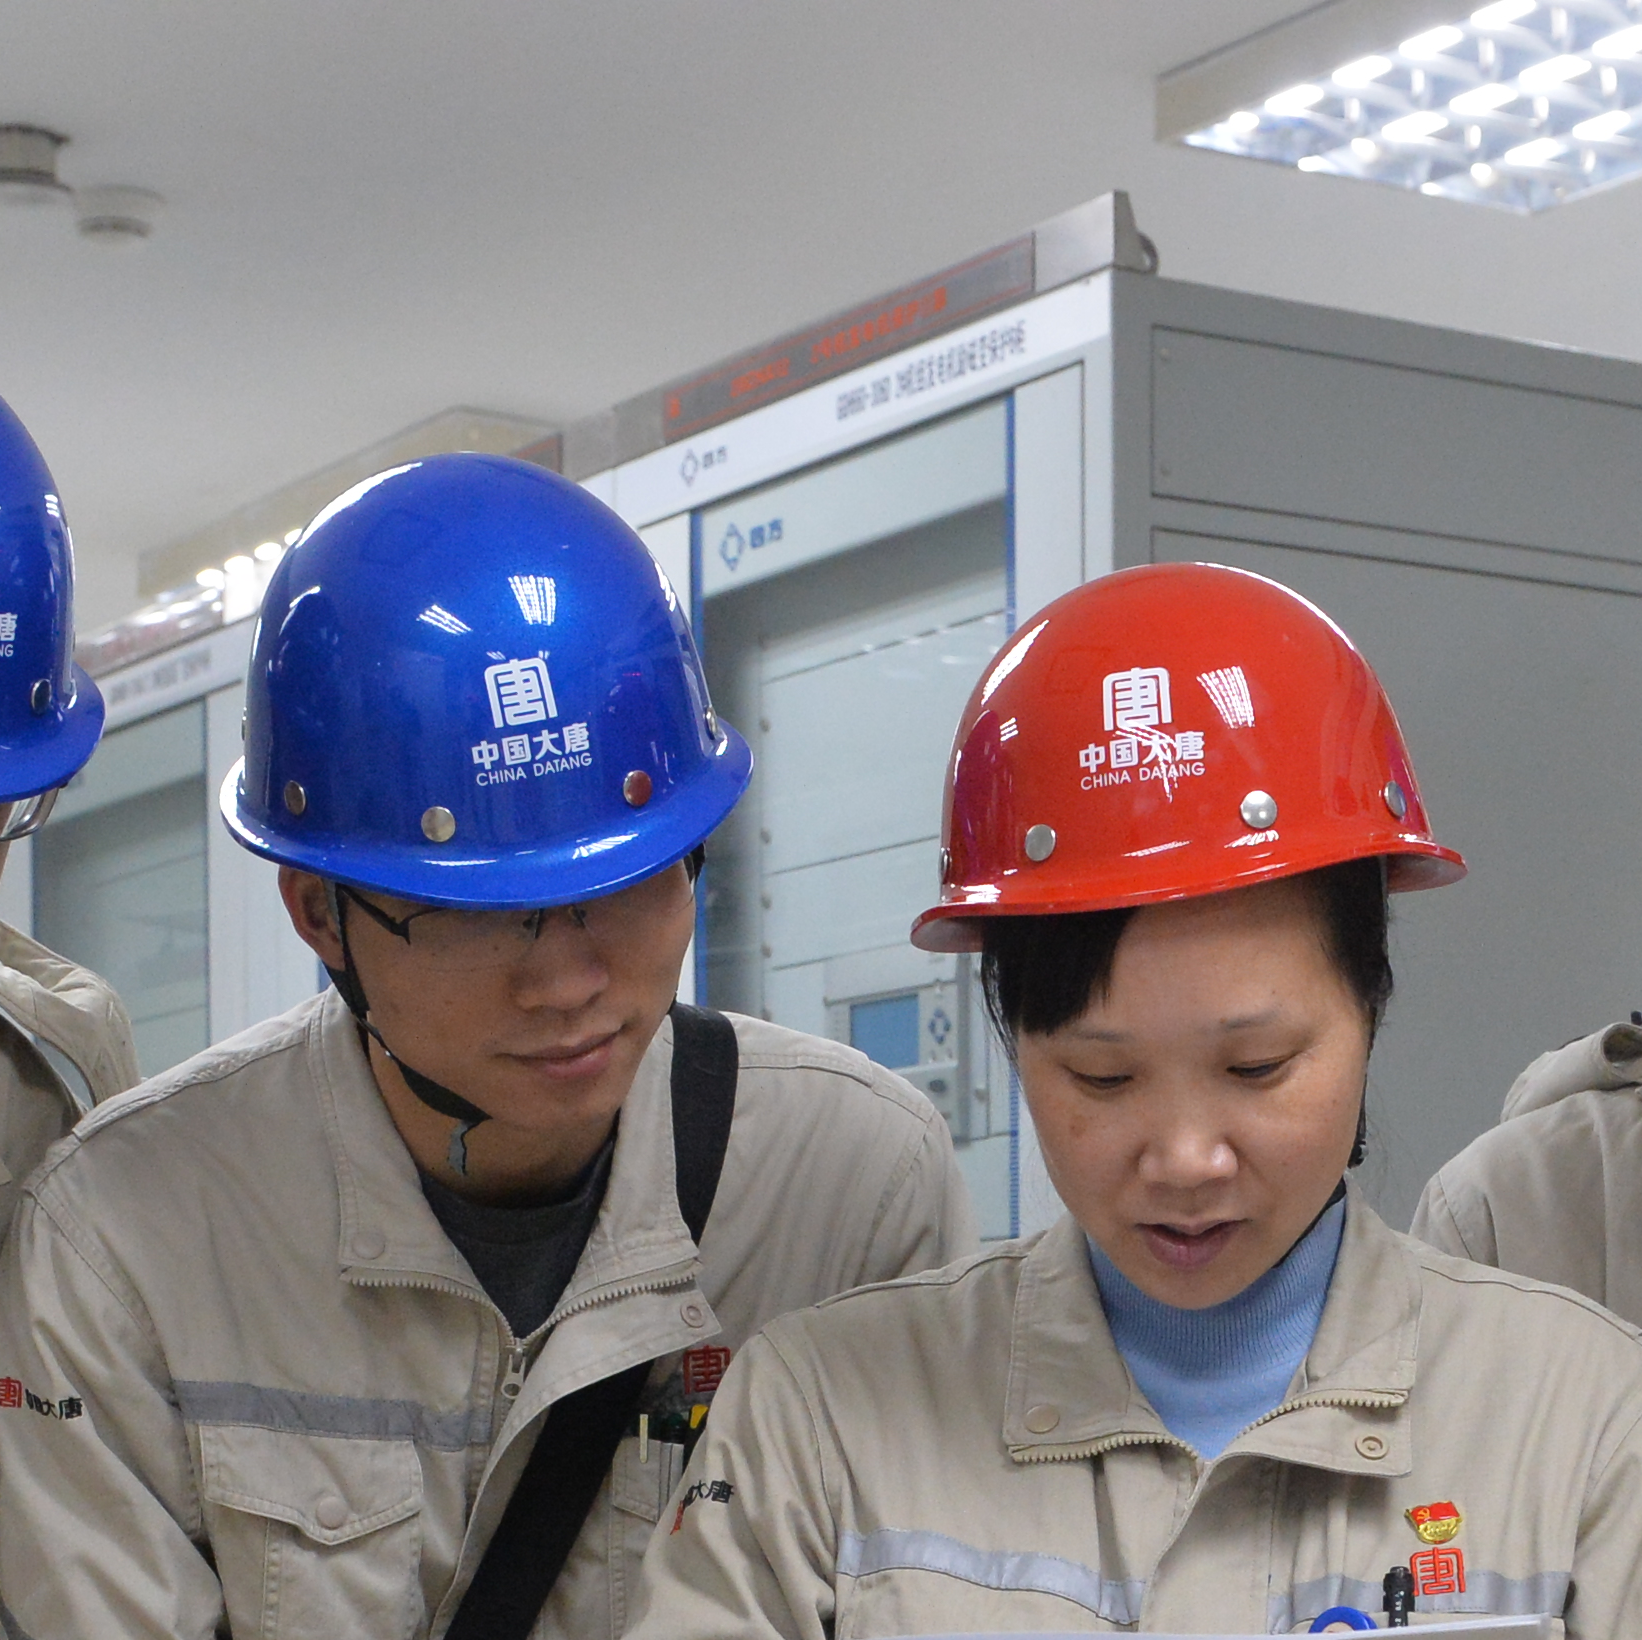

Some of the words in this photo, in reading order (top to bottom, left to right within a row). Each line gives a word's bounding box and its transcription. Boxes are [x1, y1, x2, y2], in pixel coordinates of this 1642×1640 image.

[471, 722, 590, 770] 中国大唐
[1079, 730, 1205, 774] 中国大唐
[476, 766, 527, 786] CHINA
[533, 752, 593, 777] DATANG
[1080, 769, 1132, 791] CHINA
[1138, 762, 1206, 782] DATANG
